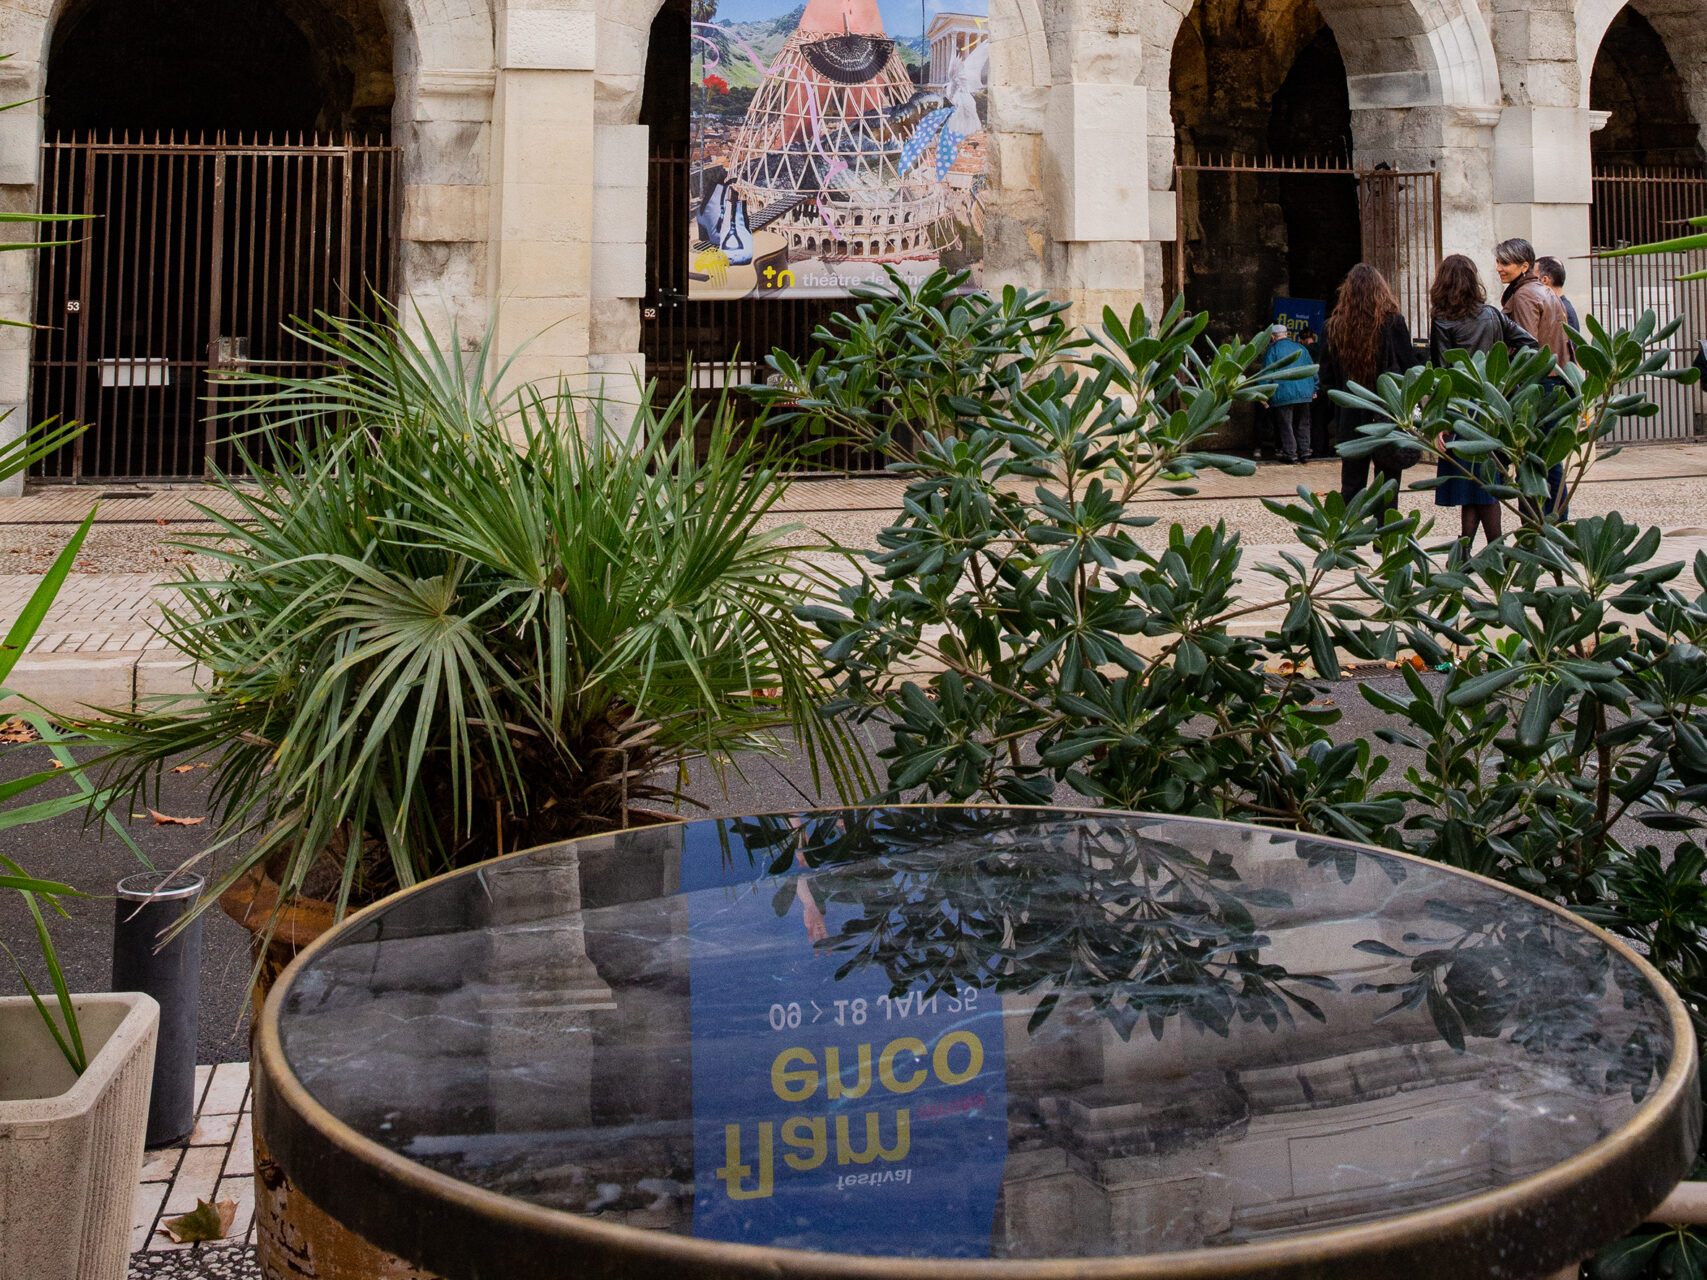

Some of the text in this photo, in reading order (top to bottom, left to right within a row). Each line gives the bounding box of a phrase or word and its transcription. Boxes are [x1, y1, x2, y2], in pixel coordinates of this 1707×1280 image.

[803, 272, 861, 287] théâtre
[67, 301, 80, 311] 53
[644, 309, 656, 317] 52
